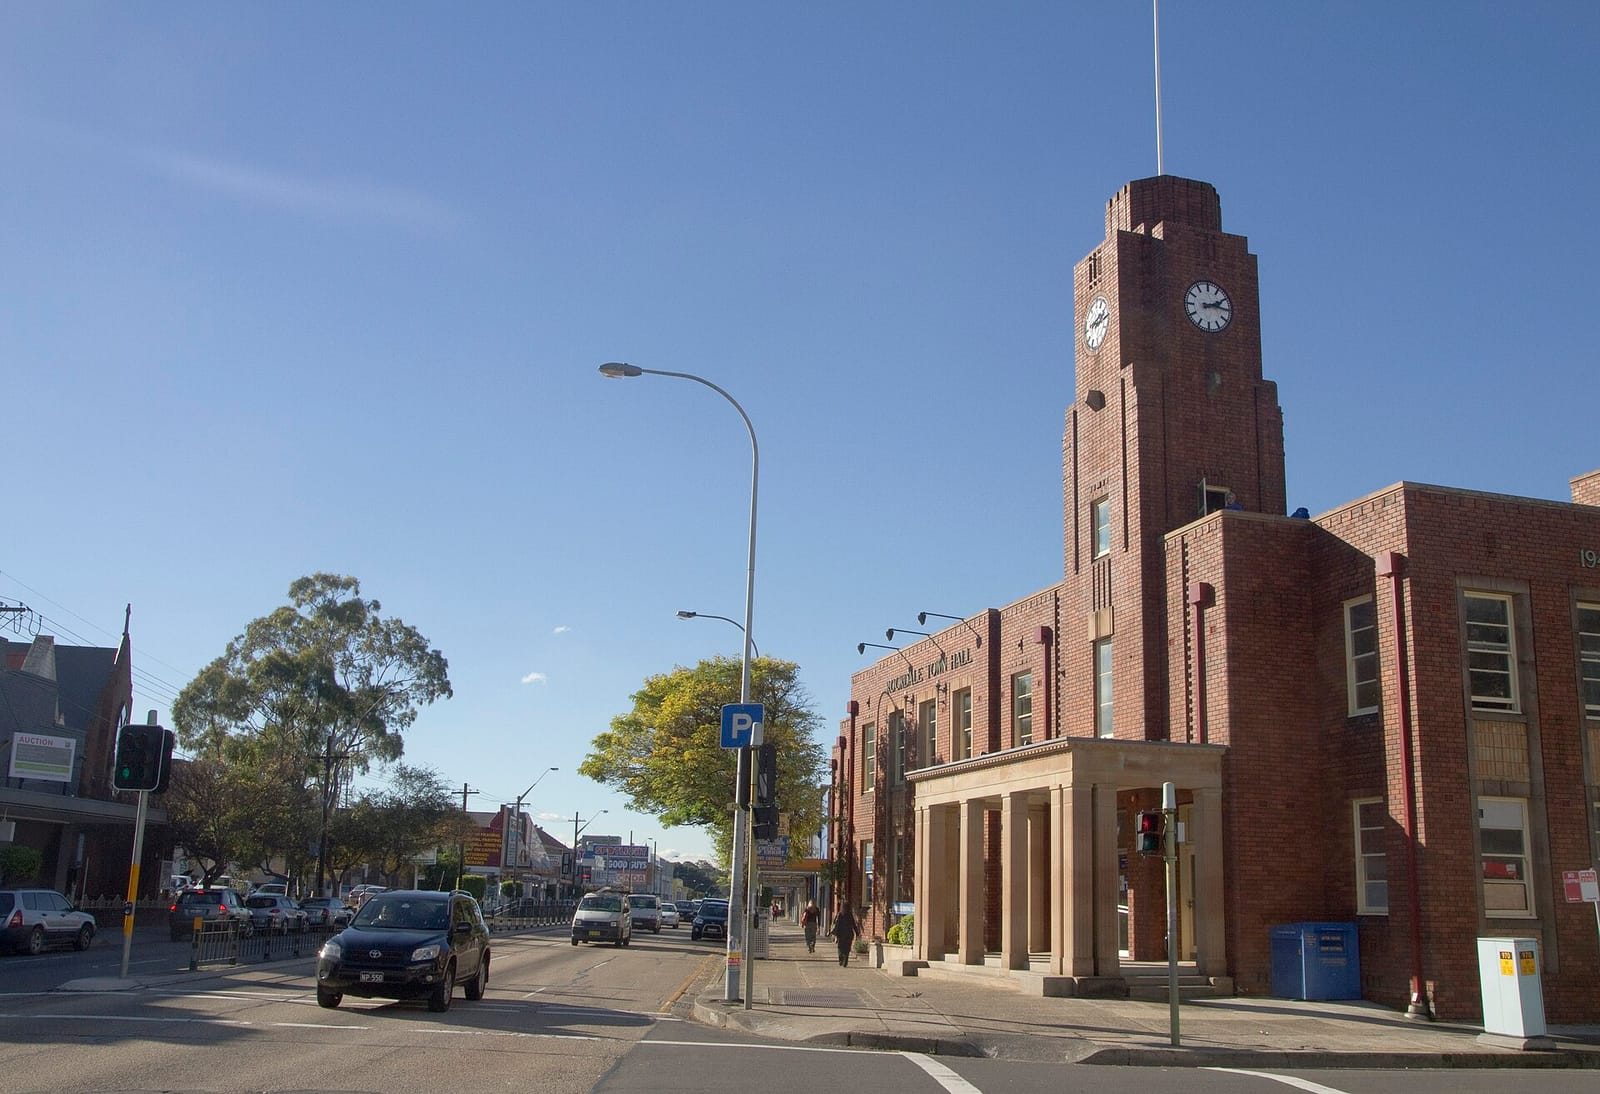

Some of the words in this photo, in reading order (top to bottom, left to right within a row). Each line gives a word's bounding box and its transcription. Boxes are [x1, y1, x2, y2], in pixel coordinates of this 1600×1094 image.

[1581, 549, 1600, 568] 19
[886, 668, 924, 694] ROCKDALE
[927, 656, 948, 679] TOWN
[951, 648, 973, 670] HALL
[732, 713, 752, 739] P
[19, 736, 53, 747] AUCTION
